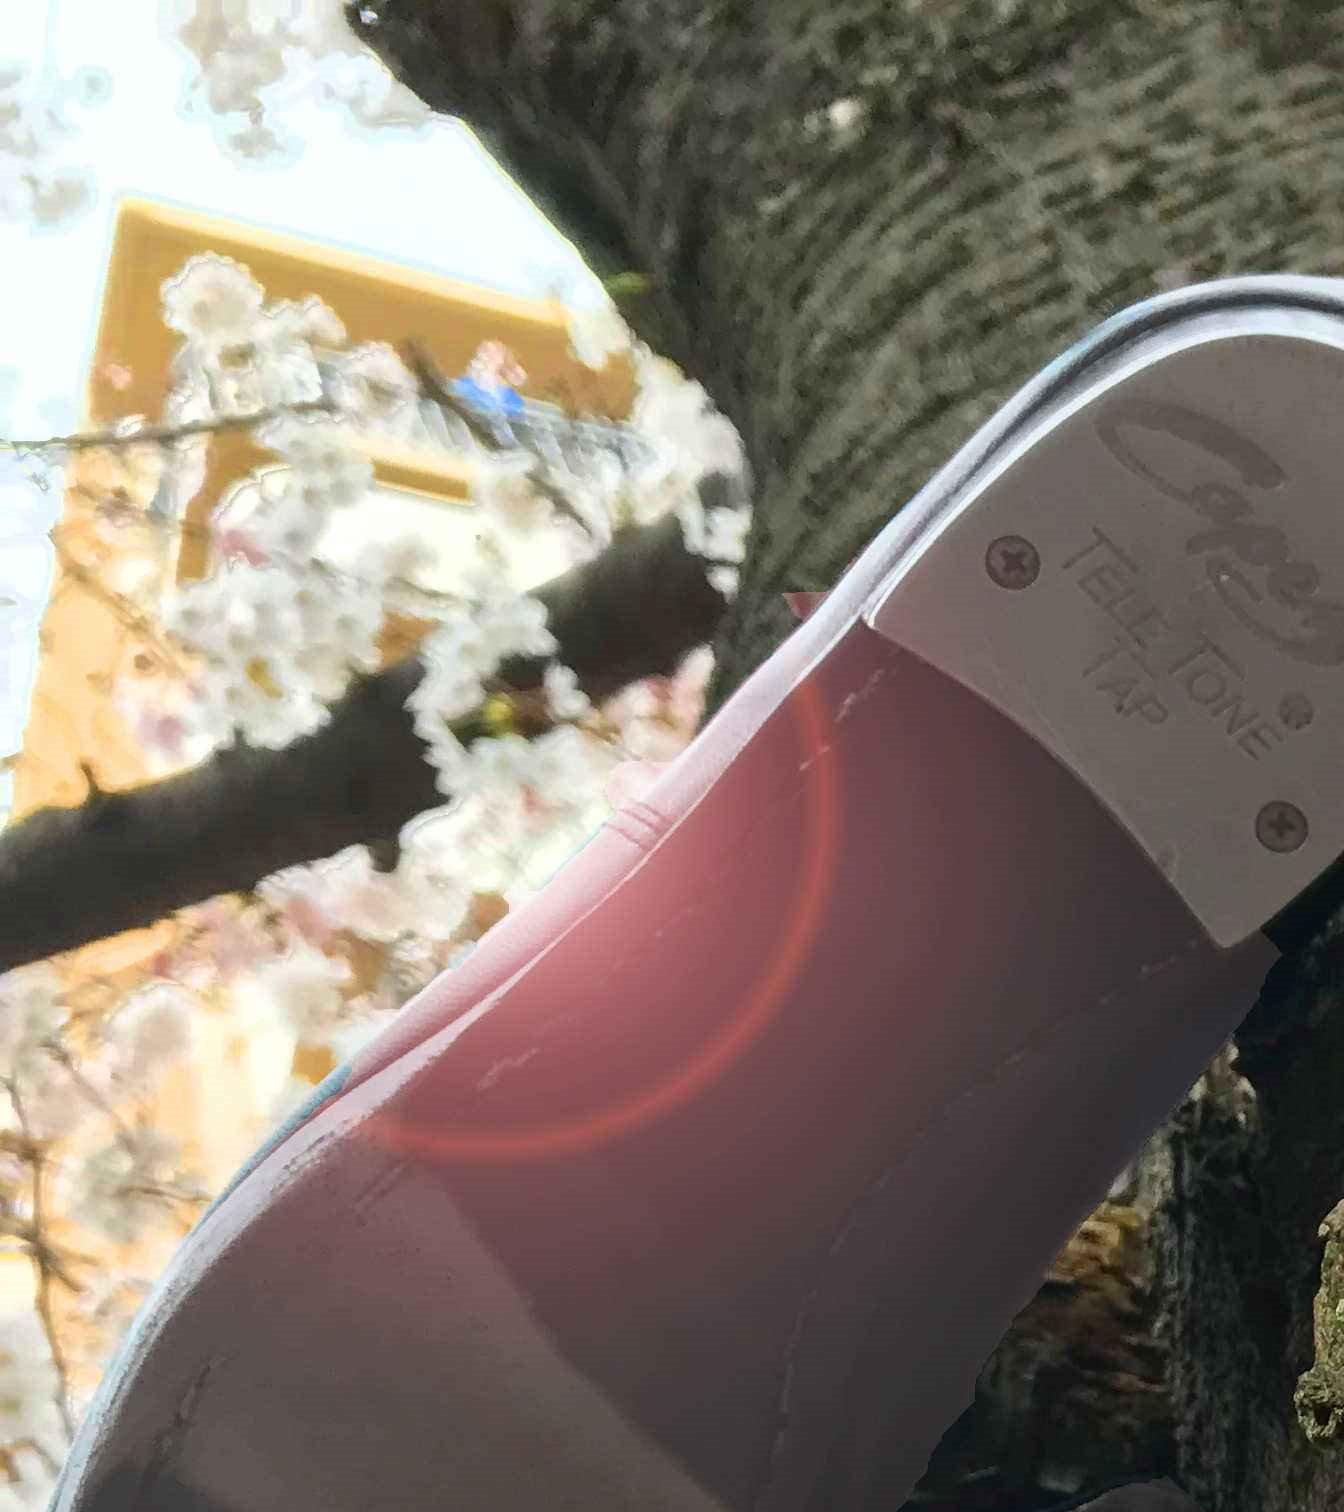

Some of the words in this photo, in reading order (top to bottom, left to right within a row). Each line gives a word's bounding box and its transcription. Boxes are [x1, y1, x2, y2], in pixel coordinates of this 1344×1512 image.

[1062, 527, 1173, 649] TELE
[1168, 633, 1284, 760] TONE
[1082, 636, 1169, 726] TAP
